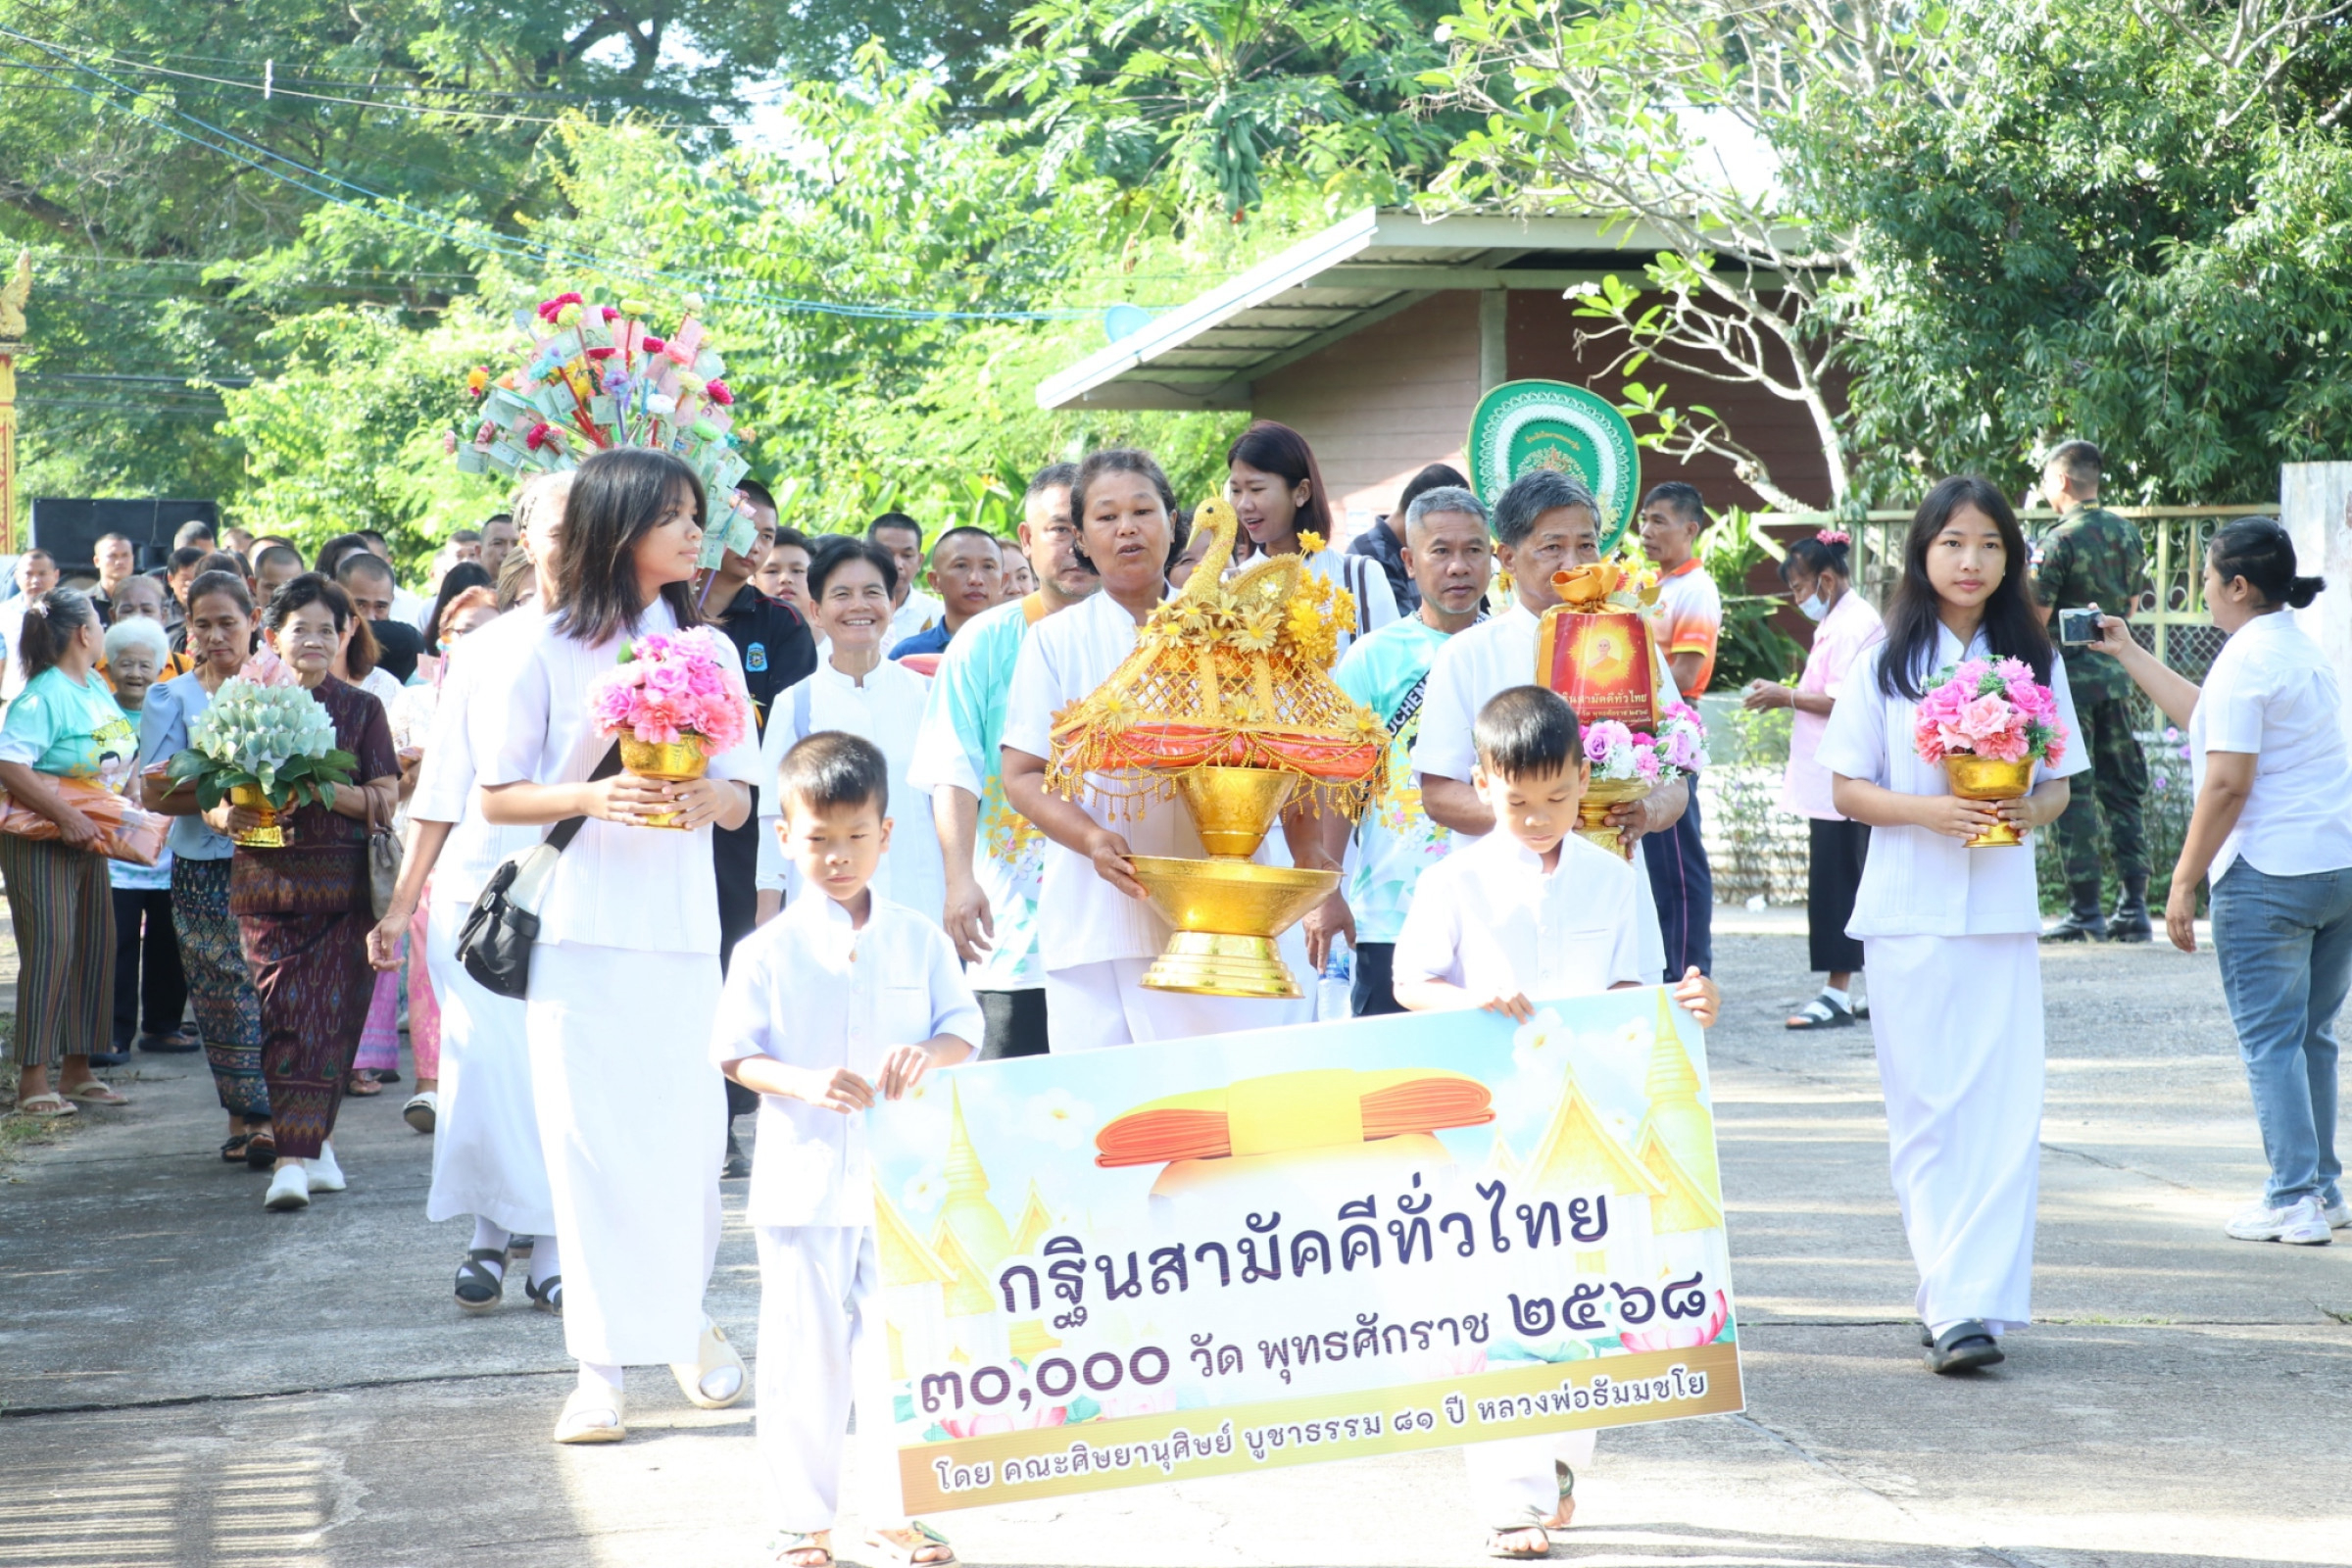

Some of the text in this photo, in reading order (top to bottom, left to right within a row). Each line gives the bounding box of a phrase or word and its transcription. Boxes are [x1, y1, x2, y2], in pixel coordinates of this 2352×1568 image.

[1000, 1172, 1609, 1330] กฐินสามัคคีทั่วไทย
[921, 1271, 1707, 1413] ๓๐,๐๐๐ วัด พุทธศักราช ๒๕๖๘
[935, 1368, 1706, 1490] โดย คณะศิษยานุศิษย์ บูชาธรรม ๘๑ ปี หลวงพ่อธัมมชโย
